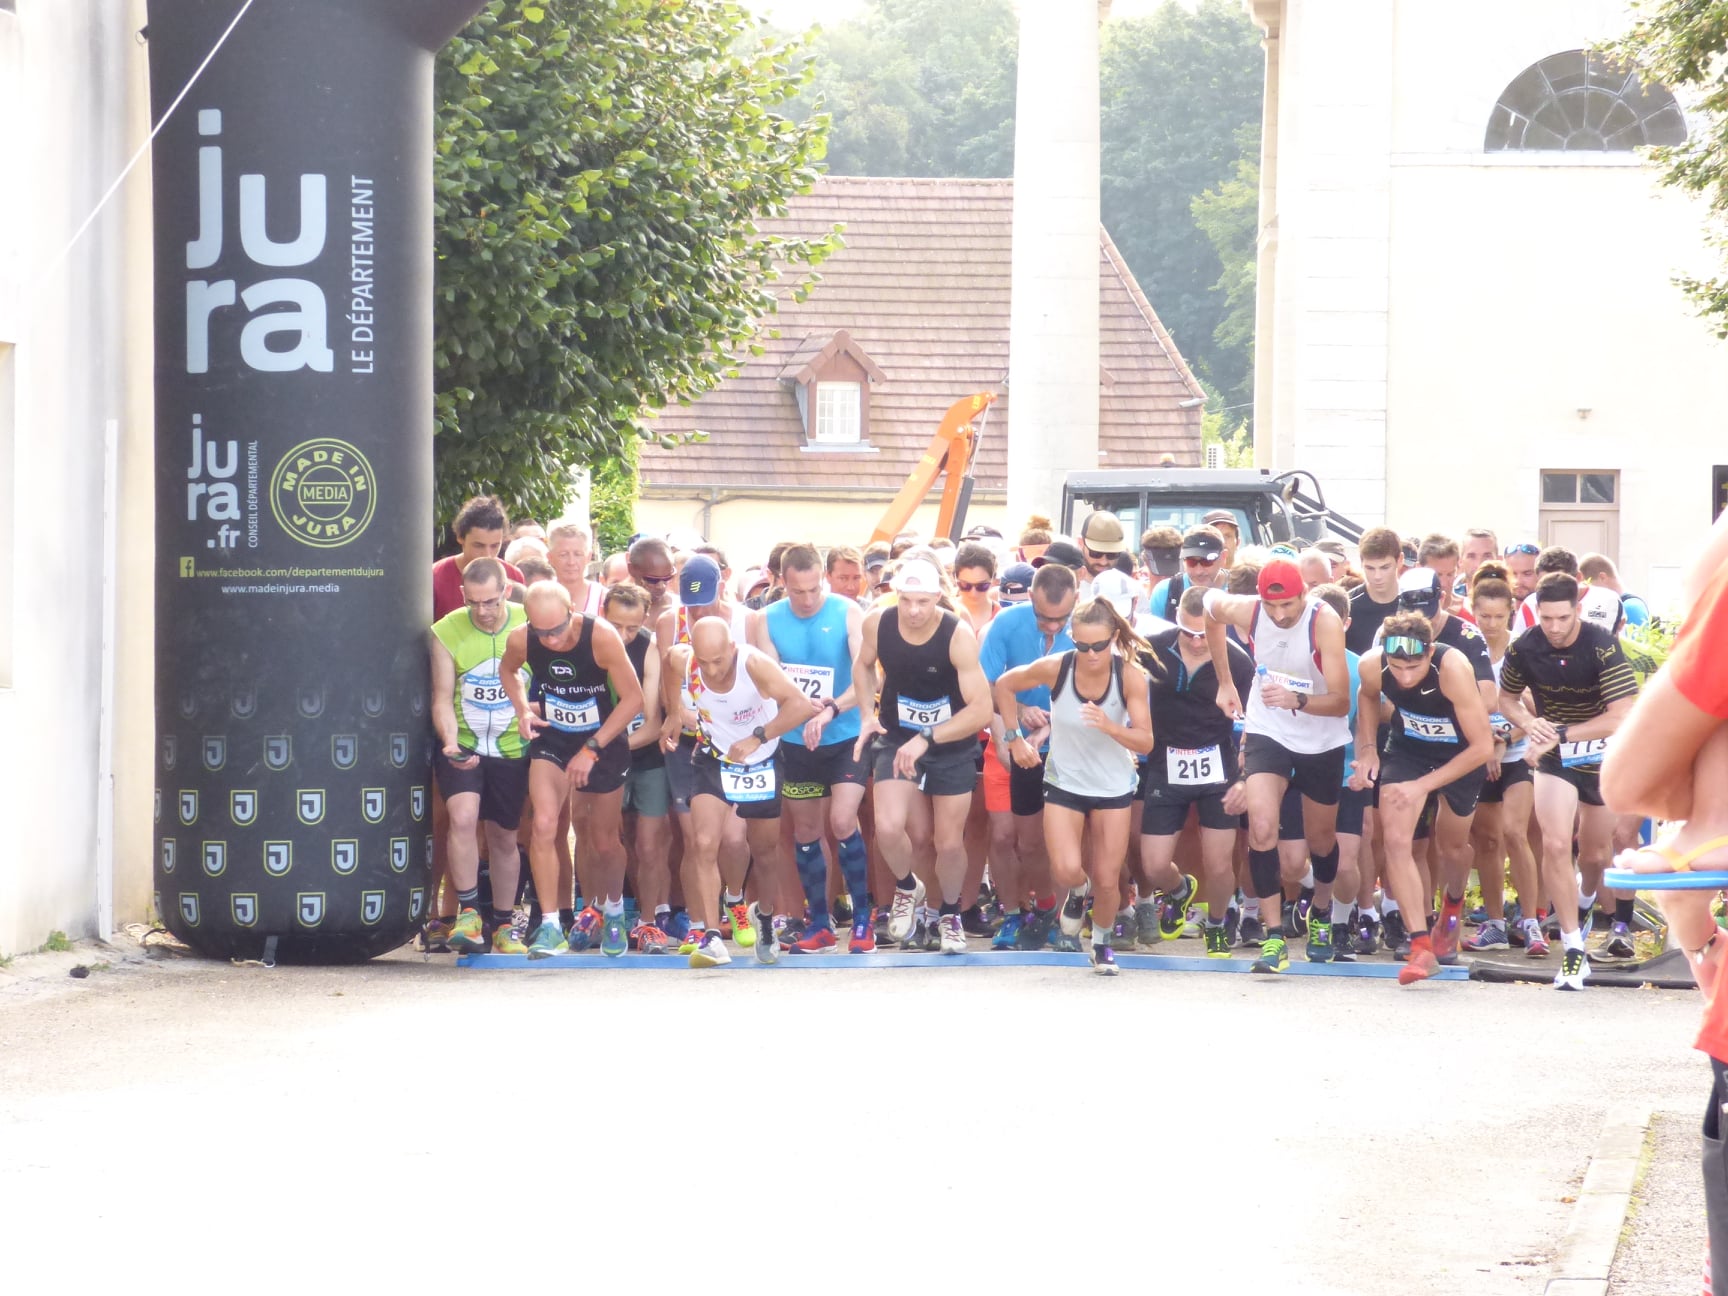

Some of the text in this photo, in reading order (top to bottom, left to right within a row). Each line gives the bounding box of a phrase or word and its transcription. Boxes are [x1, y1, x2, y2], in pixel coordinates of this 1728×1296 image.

[346, 175, 374, 374] LE DÉPARTEMENT
[282, 450, 367, 491] MADE IN
[246, 440, 258, 548] CONSEIL DÉPARTEMENTAL
[303, 487, 348, 500] MEDIA
[292, 513, 357, 536] JURA
[207, 524, 241, 548] .fr
[196, 566, 384, 578] www.facebook.com/departementdujura
[221, 583, 340, 595] www.madeinjura.media
[554, 709, 587, 723] 801
[907, 708, 941, 723] 767
[1178, 757, 1211, 779] 215
[730, 774, 767, 790] 793
